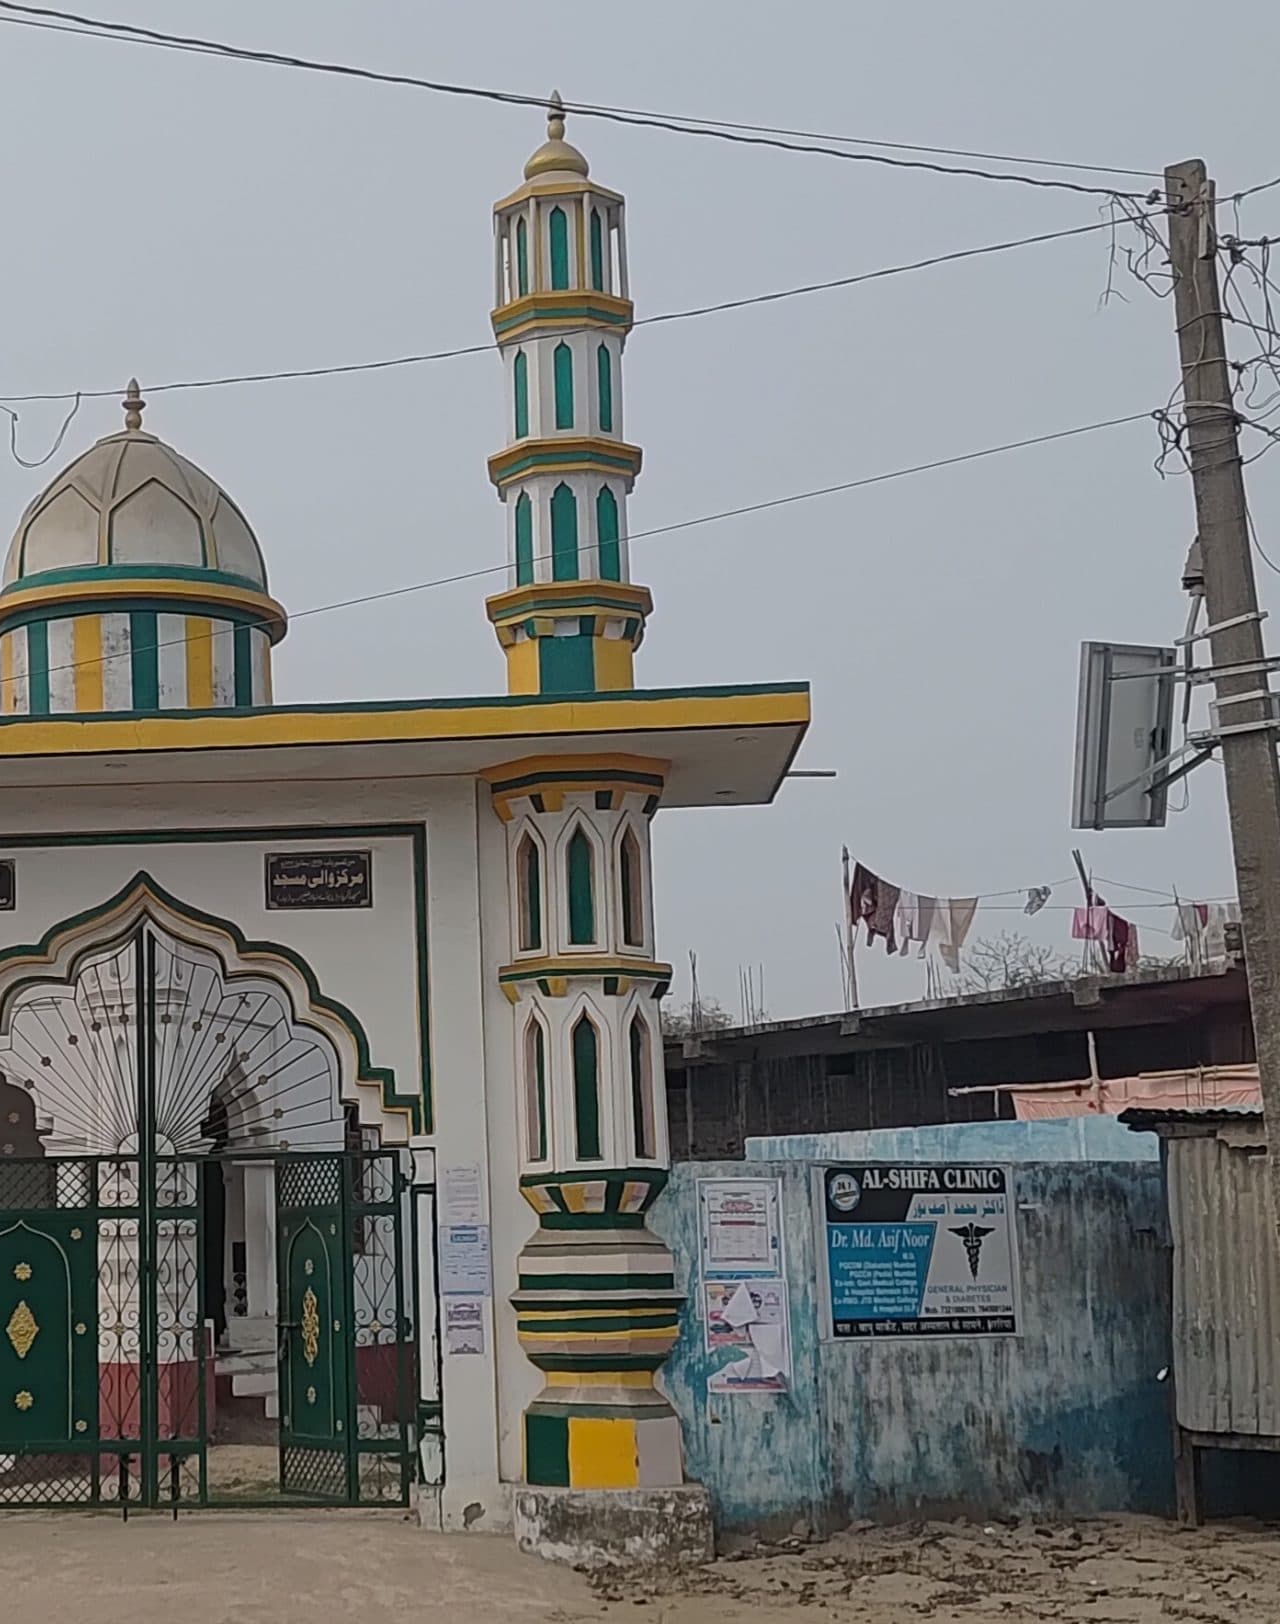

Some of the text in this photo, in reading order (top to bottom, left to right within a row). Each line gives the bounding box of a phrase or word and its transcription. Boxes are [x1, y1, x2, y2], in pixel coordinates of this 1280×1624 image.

[272, 871, 307, 889] مسجد
[862, 1168, 1001, 1190] AL-SHIFA CLINIC
[953, 1202, 977, 1215] محمد
[831, 1229, 930, 1253] Dr. Md. Asif Noor
[927, 1285, 964, 1294] GENERAL
[966, 1284, 1008, 1293] PHYSICIAN
[952, 1294, 992, 1303] DIABETES
